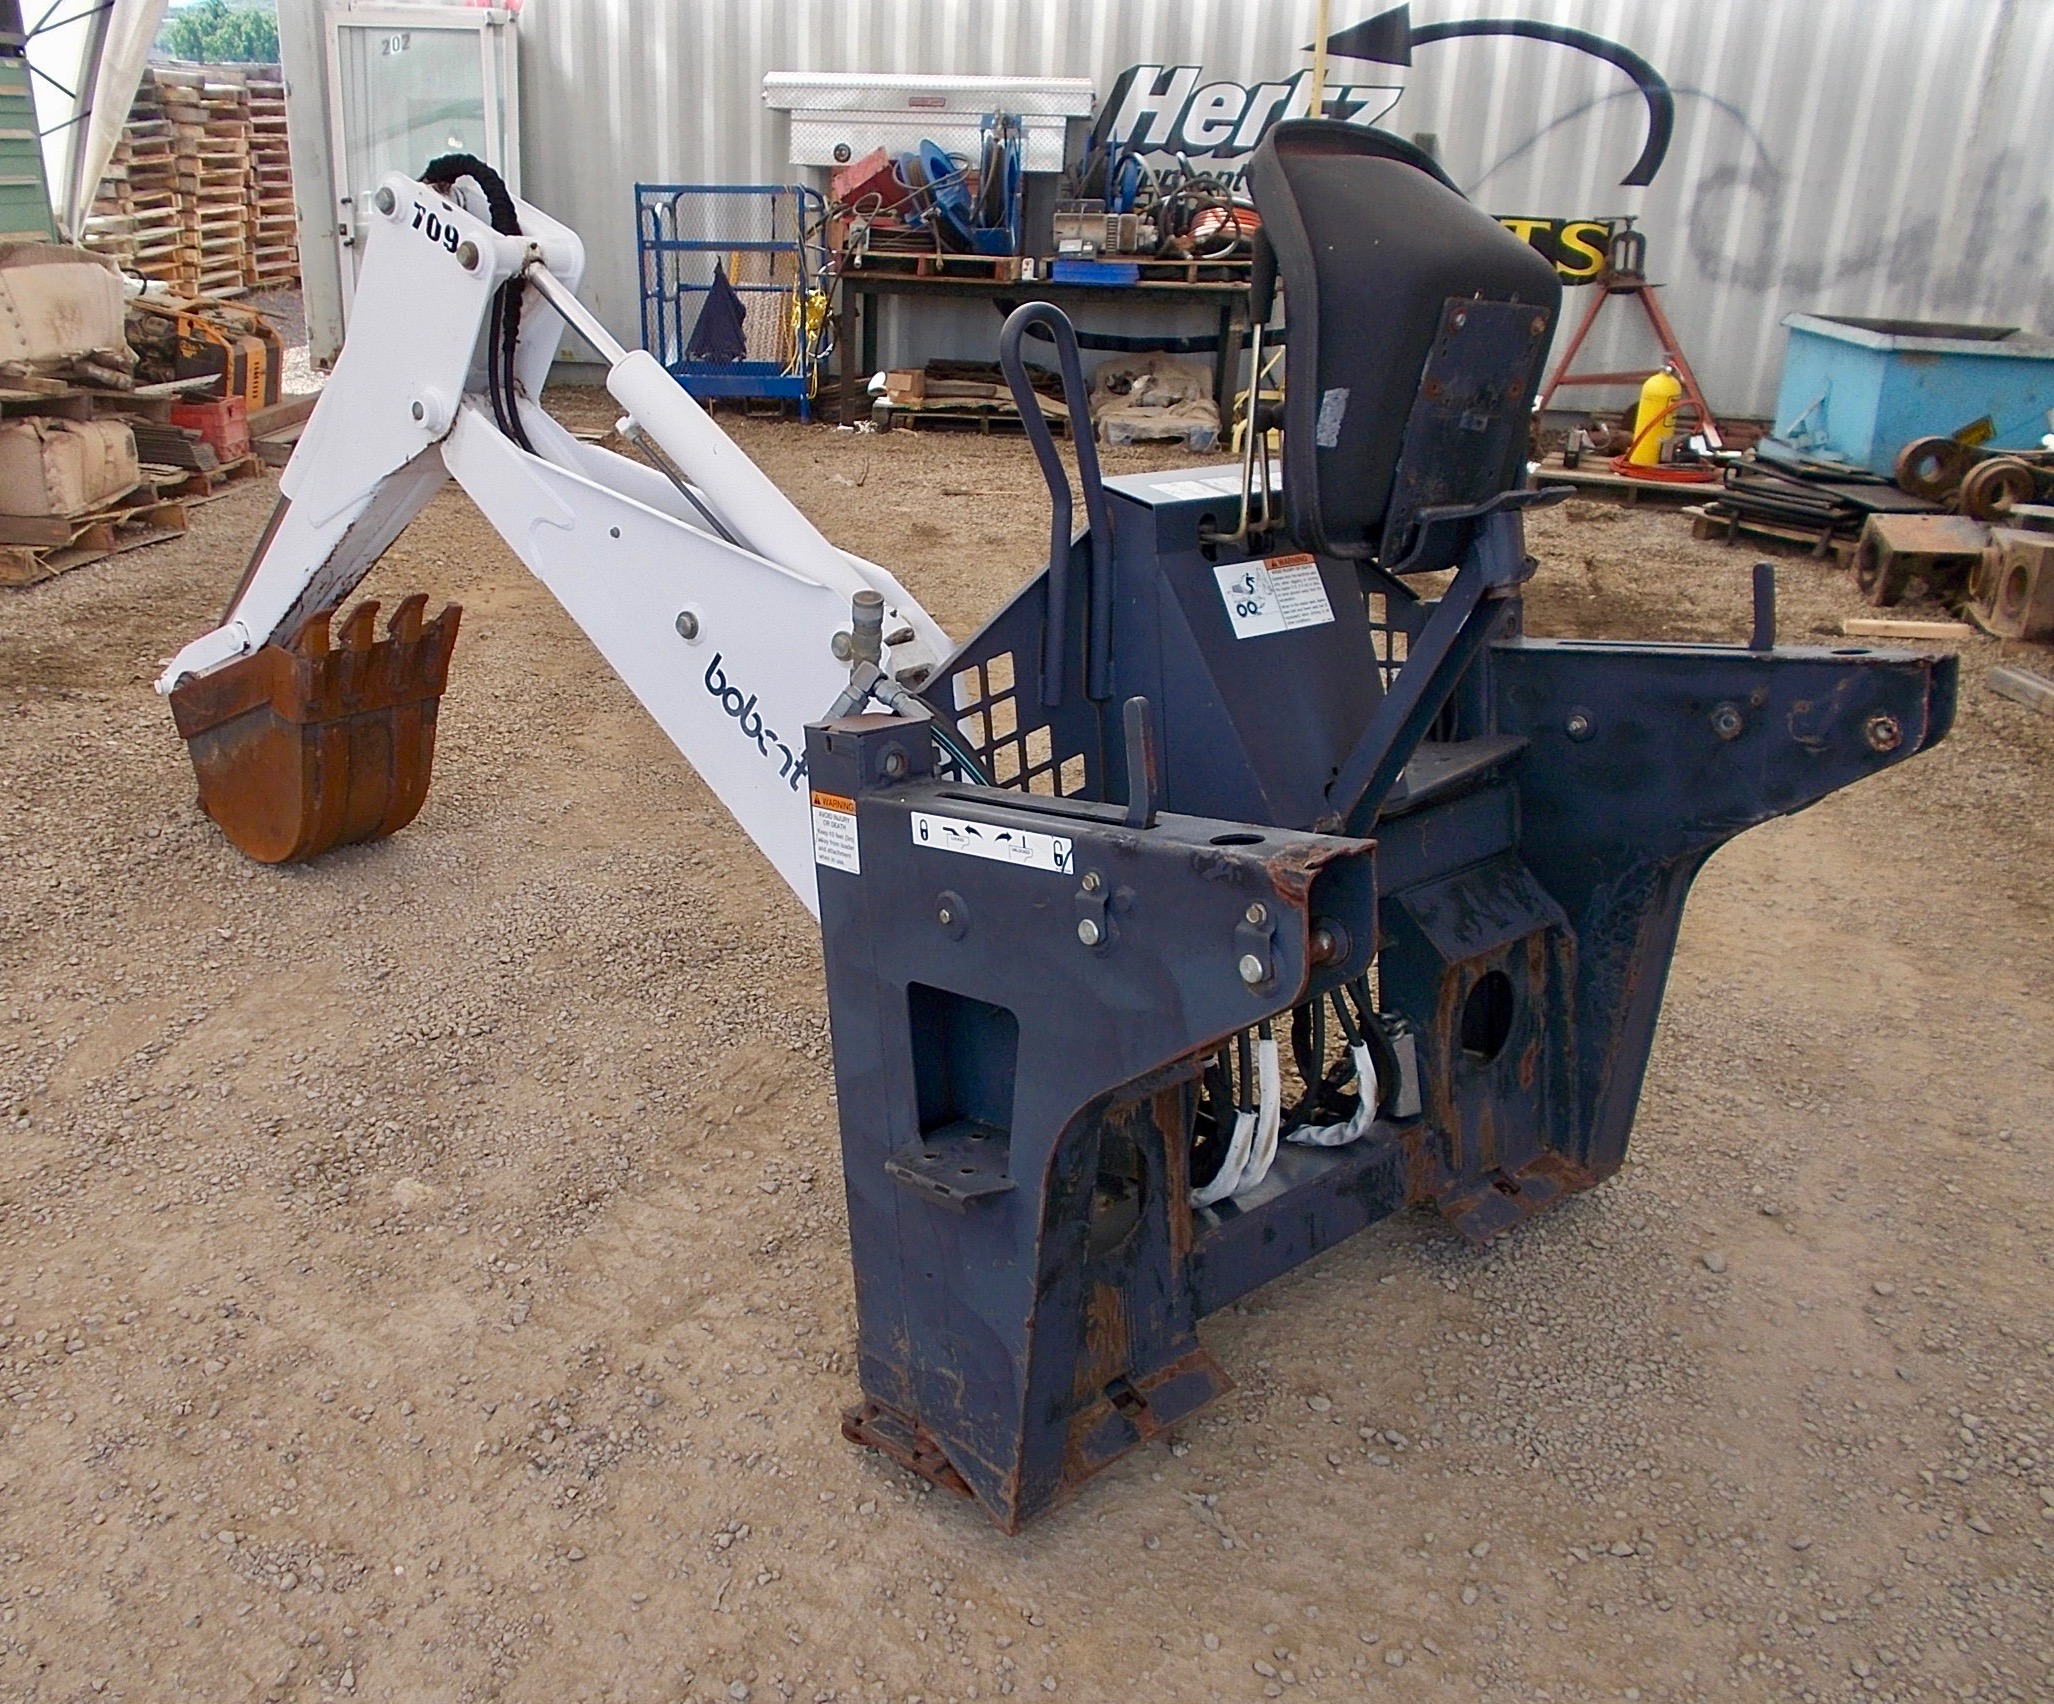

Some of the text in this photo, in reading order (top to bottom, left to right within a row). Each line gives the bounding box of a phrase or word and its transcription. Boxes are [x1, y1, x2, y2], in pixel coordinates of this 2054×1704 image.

[381, 33, 411, 56] 202
[1098, 64, 1405, 153] Hertz
[411, 200, 460, 254] 709
[822, 798, 855, 811] WARNING
[818, 811, 850, 823] AVOID INJURY
[831, 820, 847, 830] DEATH
